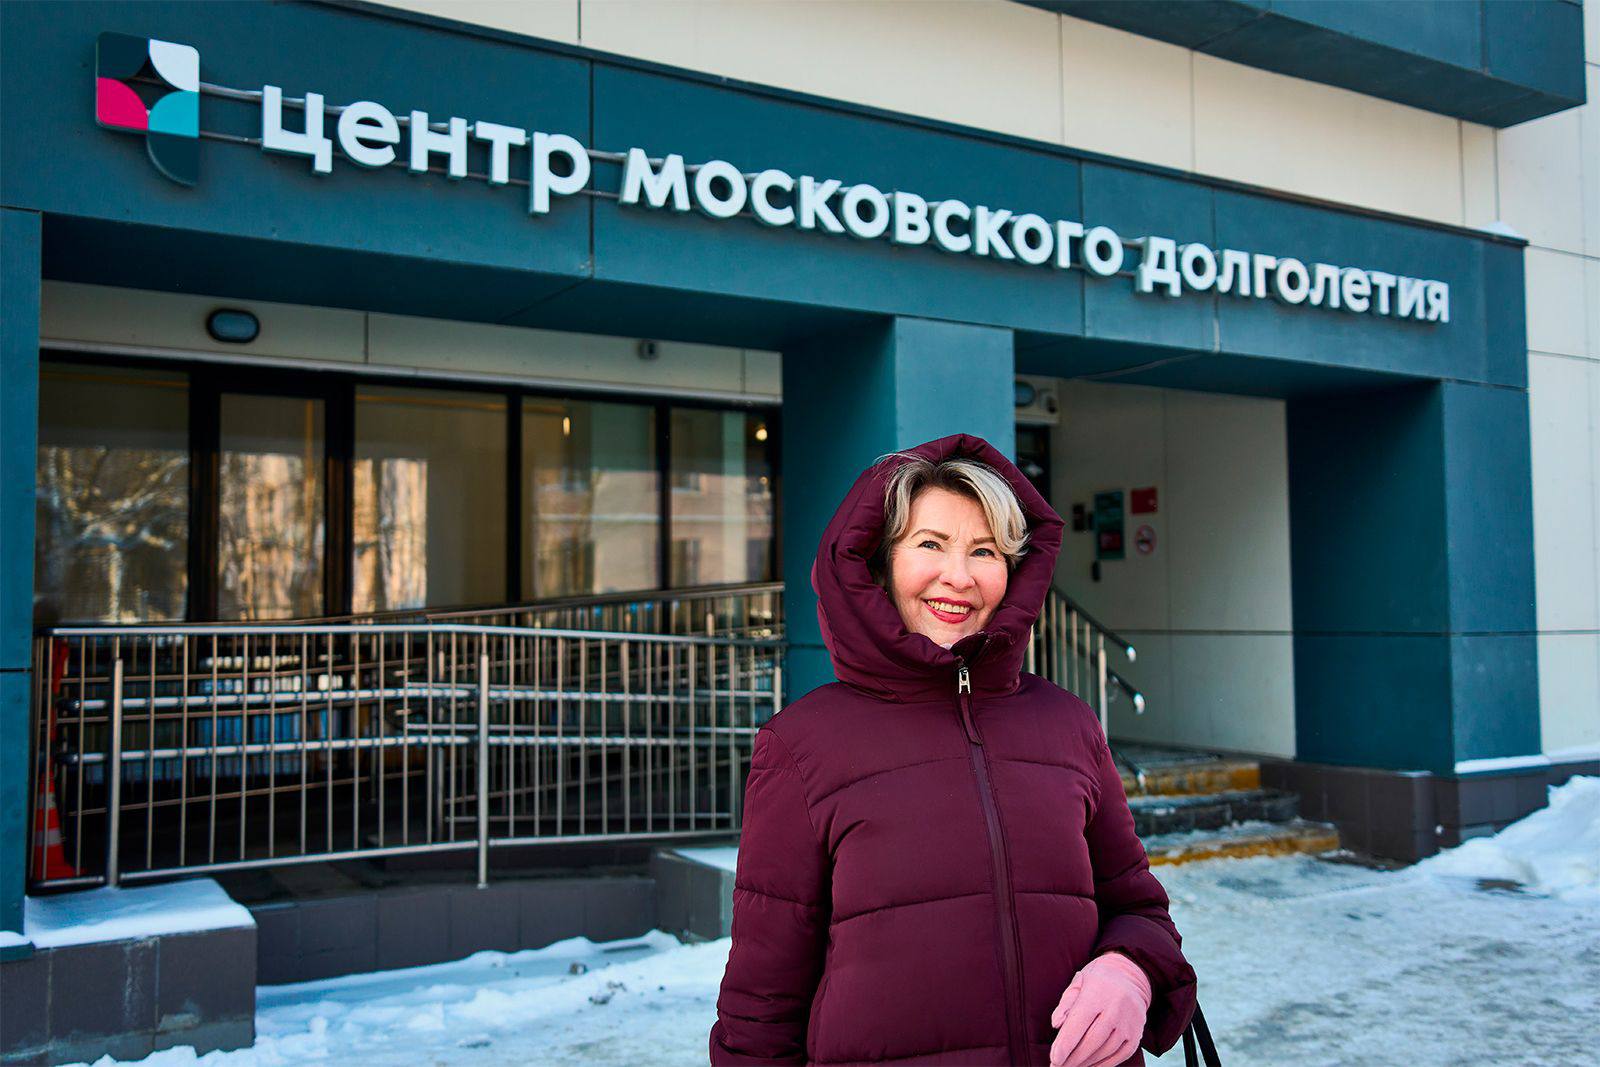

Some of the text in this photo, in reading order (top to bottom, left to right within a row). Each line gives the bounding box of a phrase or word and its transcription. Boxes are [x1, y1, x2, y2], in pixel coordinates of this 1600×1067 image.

[261, 85, 1451, 323] центр московского долголетия
